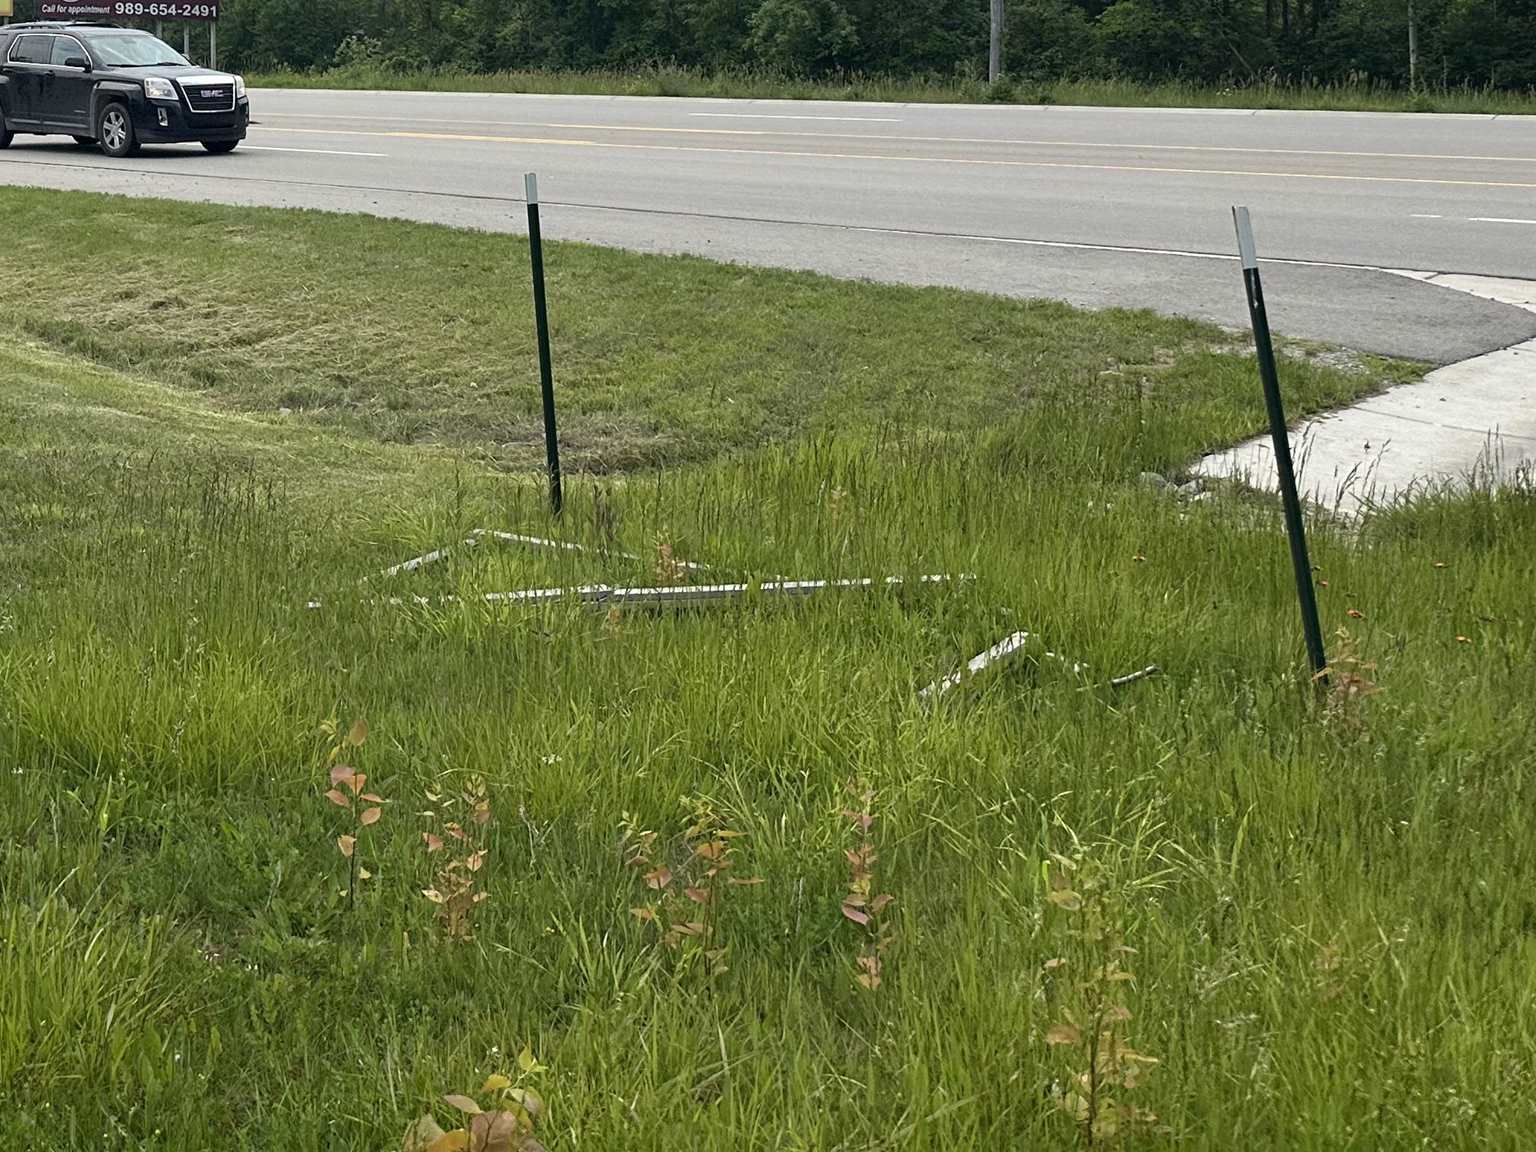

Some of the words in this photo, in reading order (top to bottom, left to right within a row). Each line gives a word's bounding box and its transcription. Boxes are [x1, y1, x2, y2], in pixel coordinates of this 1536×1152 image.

[42, 4, 56, 13] Call
[57, 5, 66, 13] for
[67, 5, 110, 14] appointment
[115, 2, 216, 17] 989-654-2491
